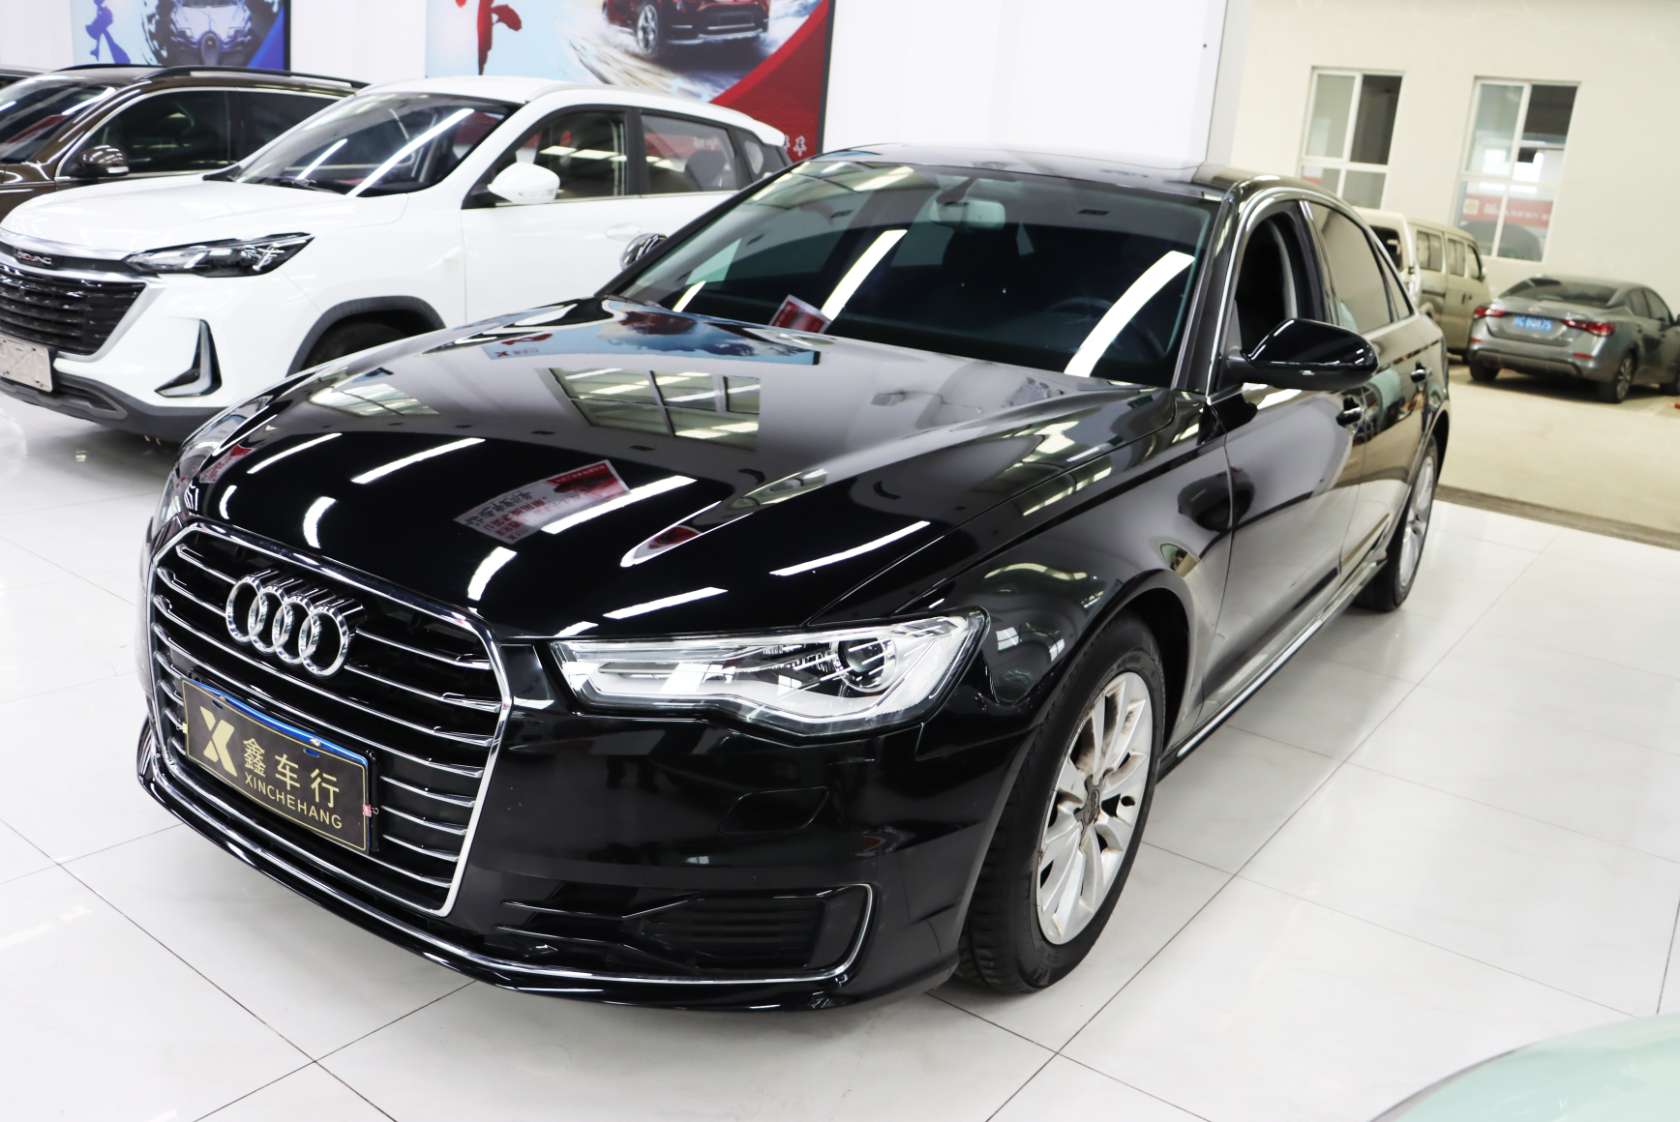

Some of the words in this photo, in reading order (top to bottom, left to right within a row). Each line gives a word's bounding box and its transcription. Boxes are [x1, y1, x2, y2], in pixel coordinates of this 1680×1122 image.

[243, 738, 340, 808] 鑫车行
[245, 774, 343, 829] XINCHEHANG
